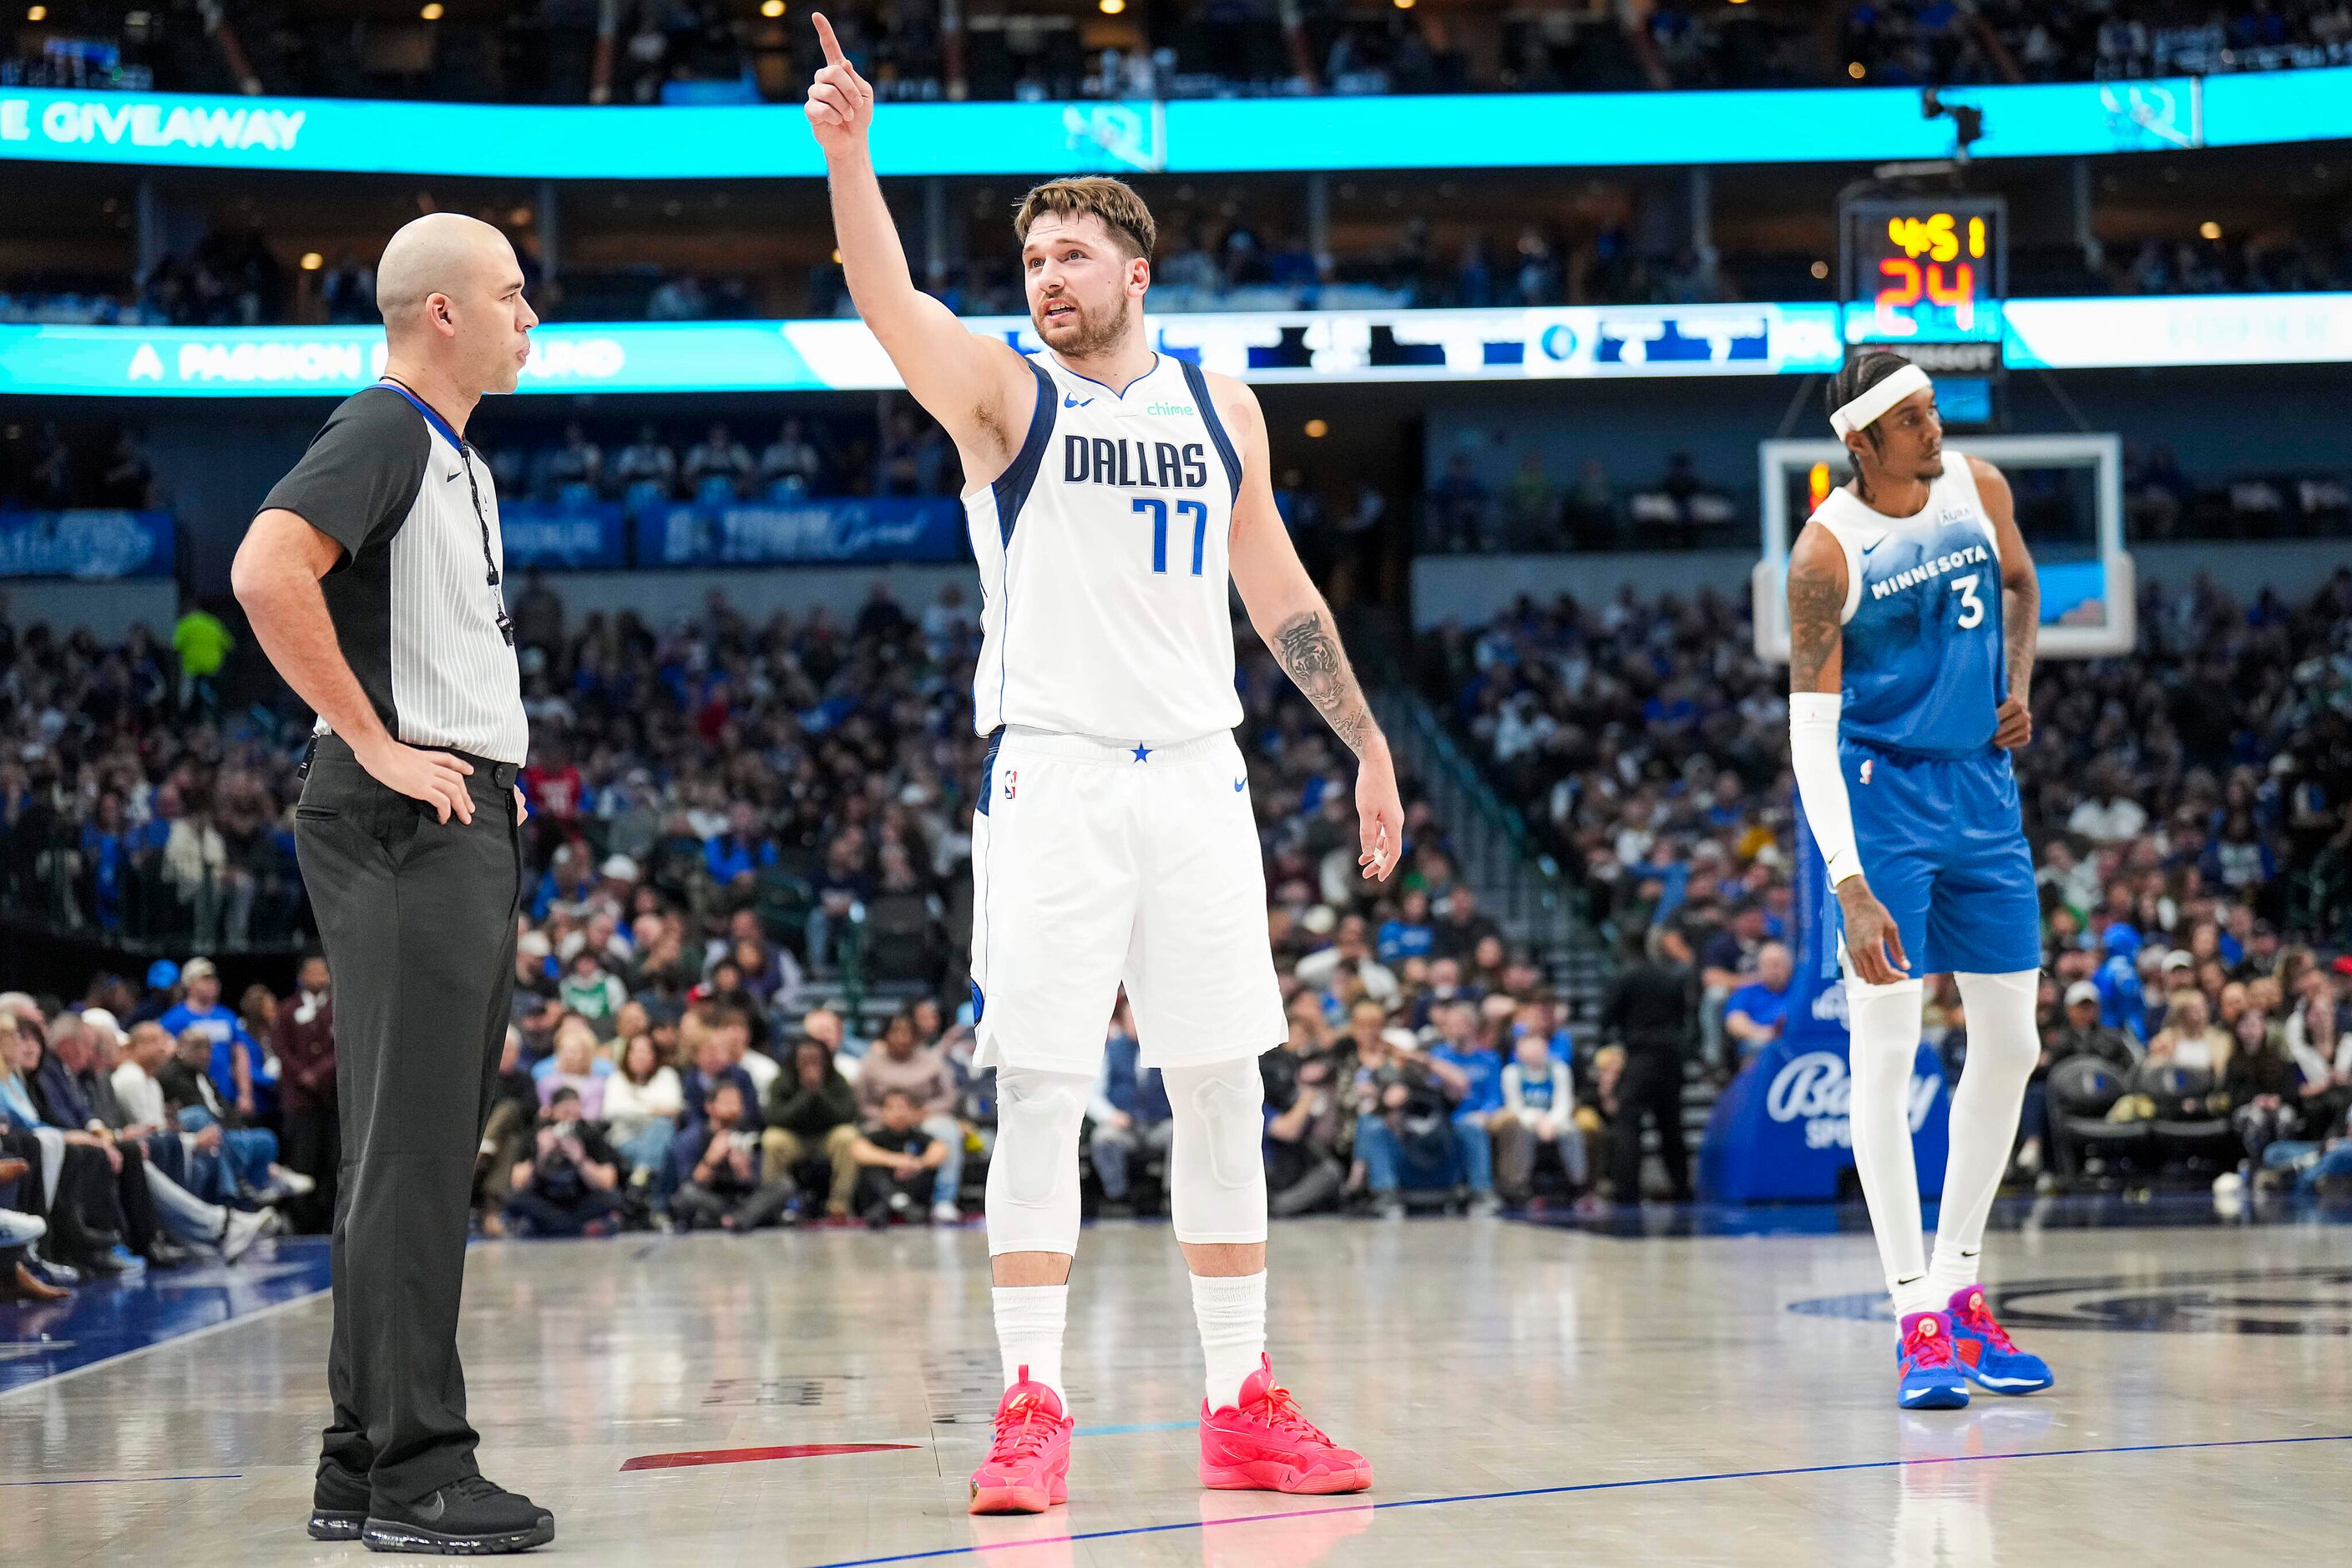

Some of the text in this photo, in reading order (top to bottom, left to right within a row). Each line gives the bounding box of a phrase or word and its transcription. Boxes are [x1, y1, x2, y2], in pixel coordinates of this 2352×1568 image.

[42, 101, 306, 150] GIVEAWAY
[1875, 258, 1974, 336] 24
[128, 342, 164, 381] A
[1146, 402, 1194, 416] chime
[1063, 434, 1208, 489] DALLAS
[1131, 497, 1209, 577] 77
[1870, 544, 1989, 601] MINNESOTA
[1950, 574, 1985, 630] 3
